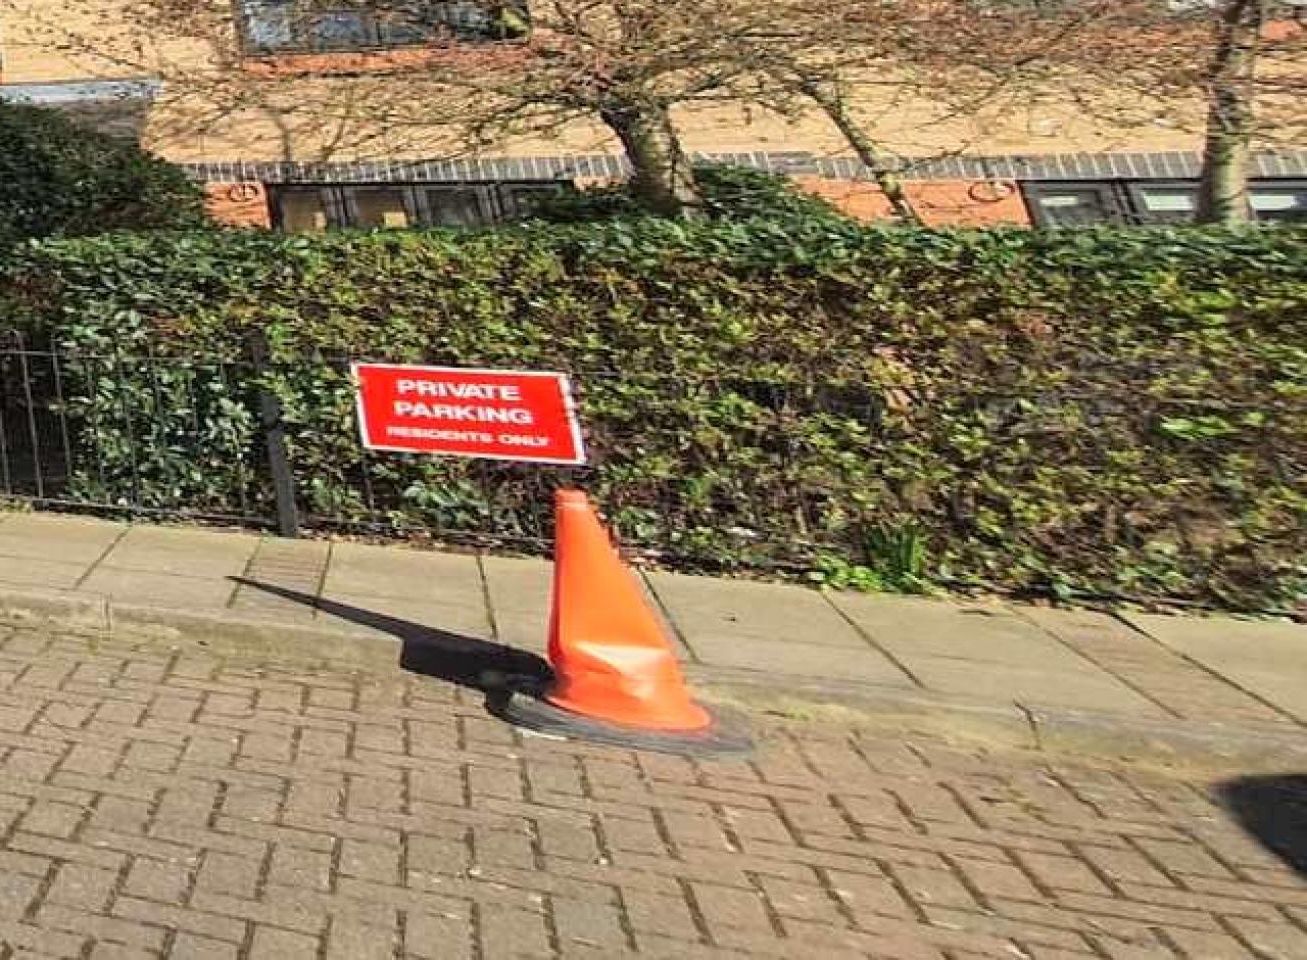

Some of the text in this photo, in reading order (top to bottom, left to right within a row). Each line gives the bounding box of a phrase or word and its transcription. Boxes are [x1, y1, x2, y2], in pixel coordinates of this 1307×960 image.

[396, 379, 522, 401] PRIVATE
[394, 401, 533, 424] PARKING
[387, 426, 549, 446] RESIDENTS ONLY
